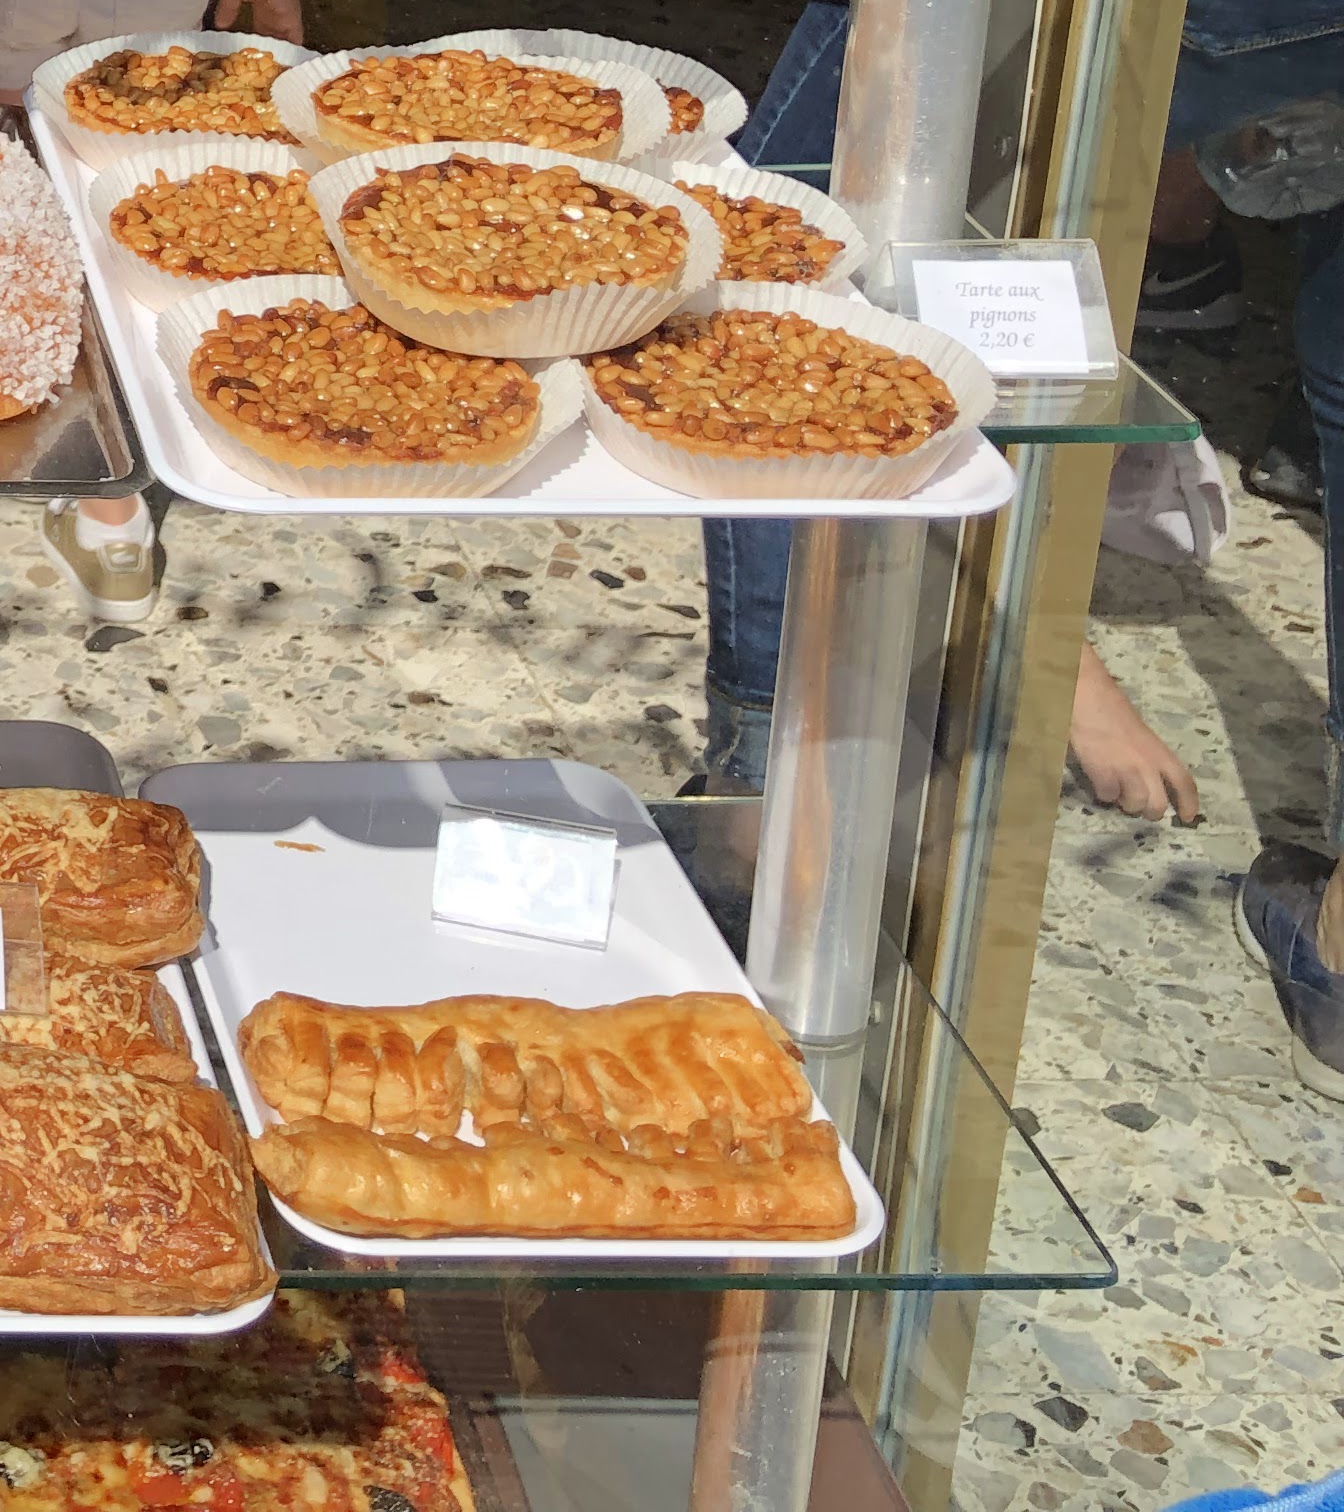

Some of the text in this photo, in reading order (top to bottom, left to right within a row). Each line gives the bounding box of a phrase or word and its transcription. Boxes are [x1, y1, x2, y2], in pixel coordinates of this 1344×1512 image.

[955, 281, 1045, 302] Tarte aux
[969, 306, 1037, 329] pignons
[979, 331, 1035, 350] 2,20 €
